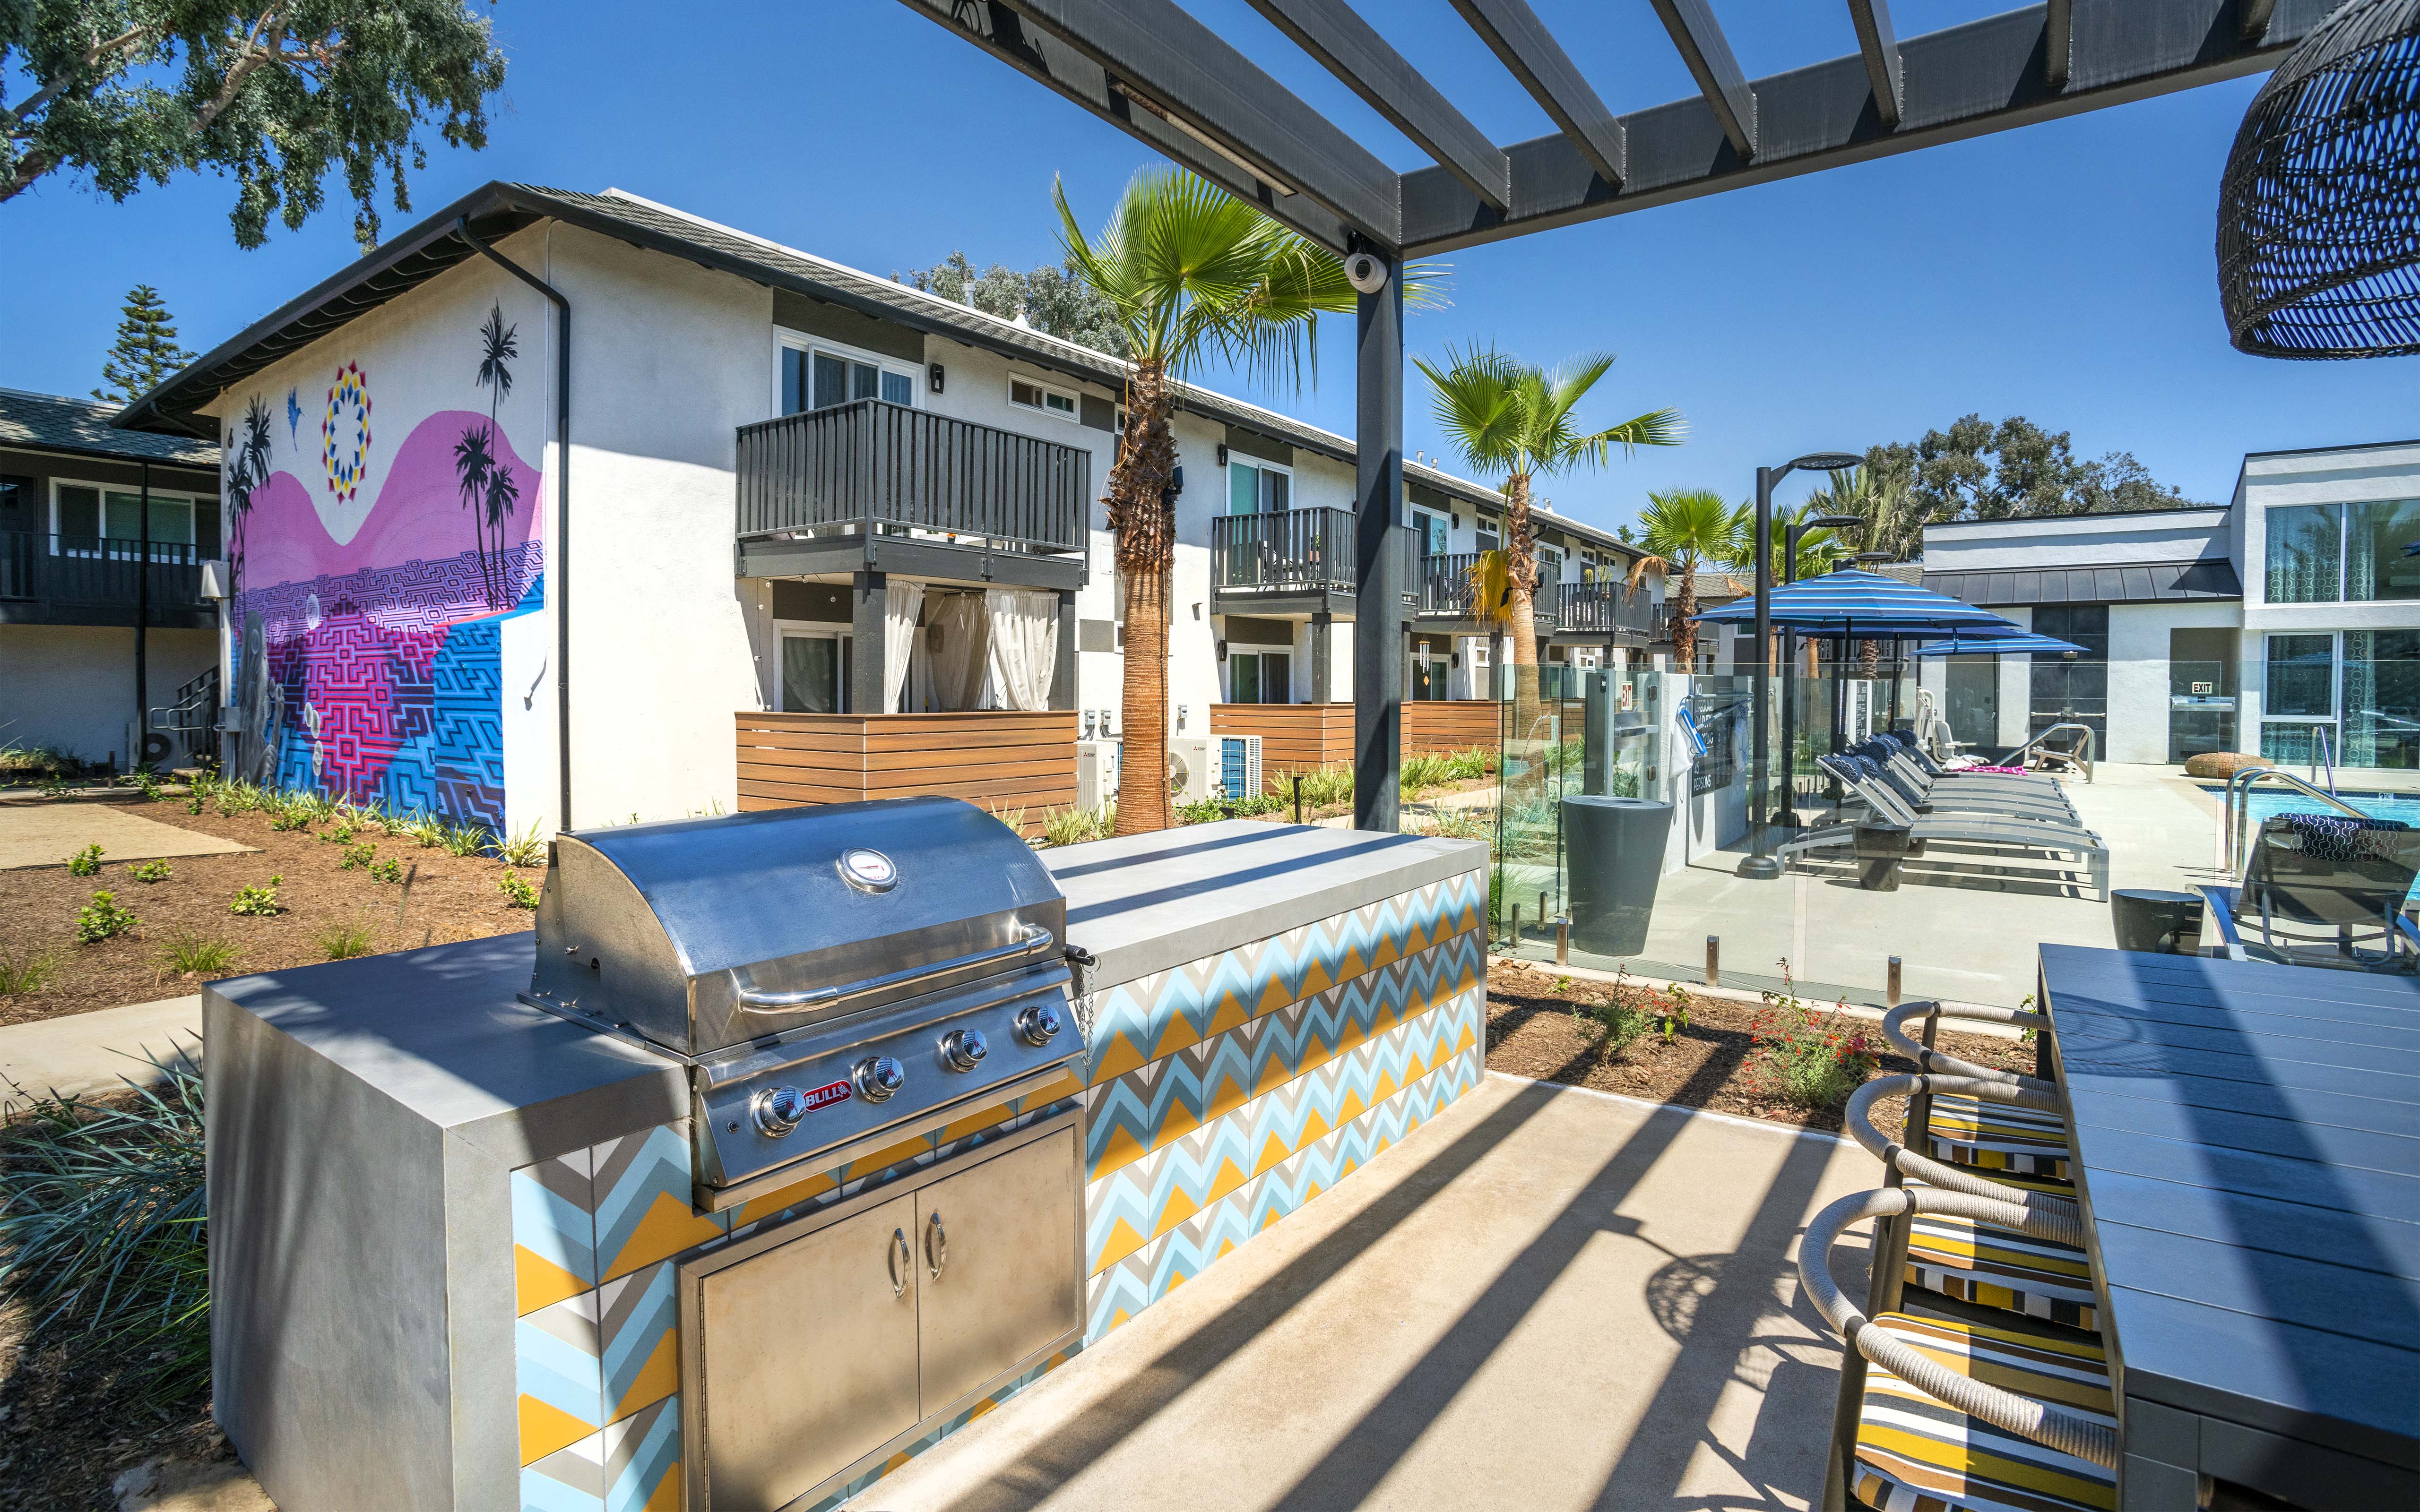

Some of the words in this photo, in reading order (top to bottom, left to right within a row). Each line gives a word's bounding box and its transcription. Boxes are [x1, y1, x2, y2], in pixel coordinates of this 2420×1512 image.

[228, 428, 233, 449] 6
[1622, 685, 1632, 707] EXIT
[1695, 683, 1702, 696] NO
[2194, 683, 2211, 693] EXIT
[1694, 774, 1711, 791] PERSONS
[805, 1087, 840, 1108] BULL
